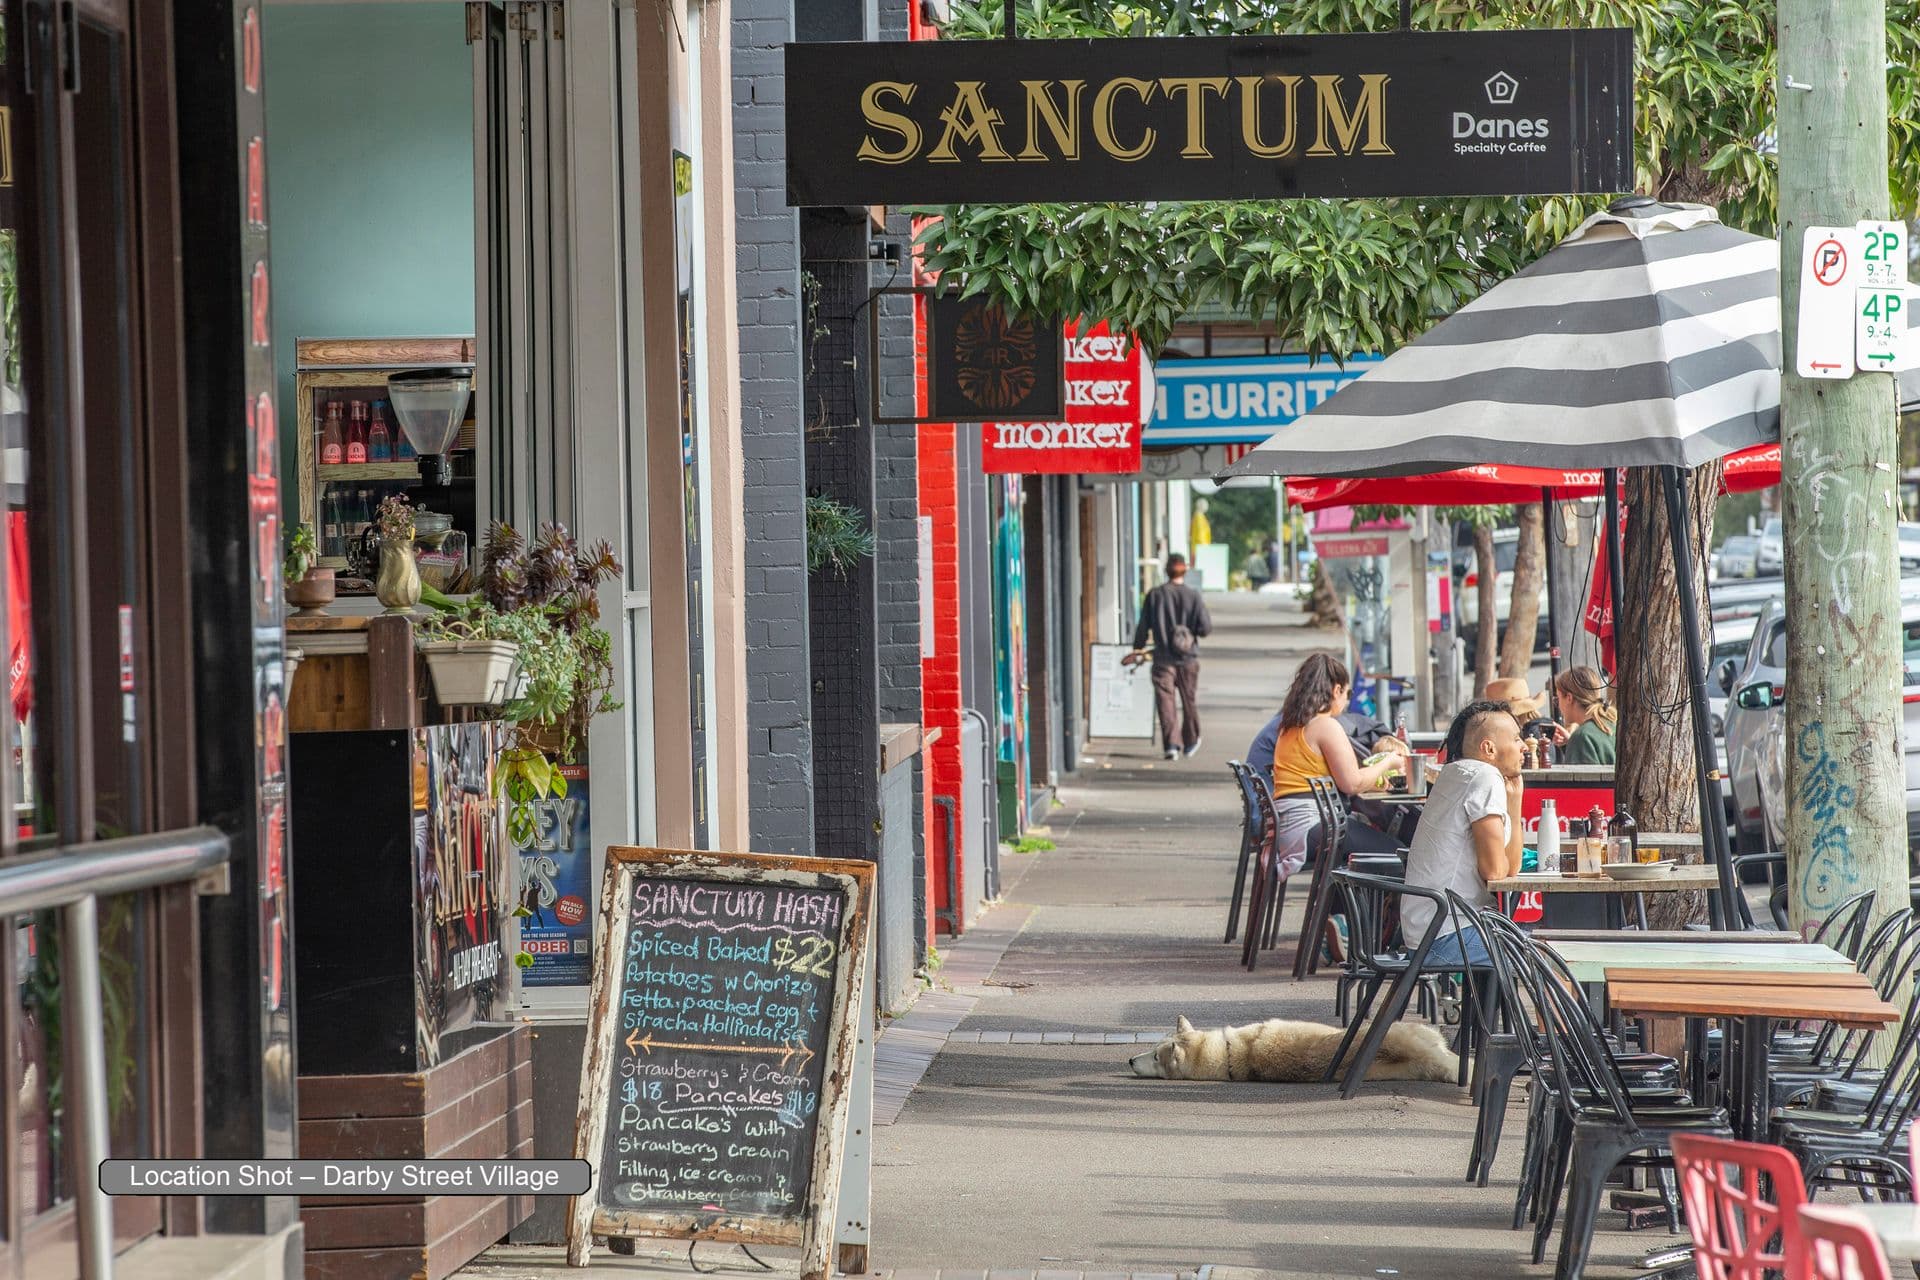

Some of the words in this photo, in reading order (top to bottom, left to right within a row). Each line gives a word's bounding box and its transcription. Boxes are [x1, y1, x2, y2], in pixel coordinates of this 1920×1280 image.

[856, 74, 1395, 164] SANCTUM
[1453, 112, 1549, 138] Danes
[1454, 142, 1506, 155] Specialty
[1508, 142, 1546, 152] Coffee
[1864, 231, 1899, 261] 2P
[1863, 294, 1901, 322] 4P
[1184, 379, 1352, 420] BURRIT
[560, 905, 583, 916] NOW
[632, 883, 765, 920] SANCTUM
[773, 890, 840, 929] HASH
[521, 940, 569, 953] TOBER
[628, 930, 700, 961] Spiced
[771, 932, 836, 979] $22
[626, 962, 715, 992] Potatoes
[765, 1006, 800, 1028] egg
[753, 1063, 811, 1088] Cream
[620, 1077, 663, 1103] $18
[618, 1133, 718, 1161] Strawberry
[629, 1182, 724, 1204] Strawberry
